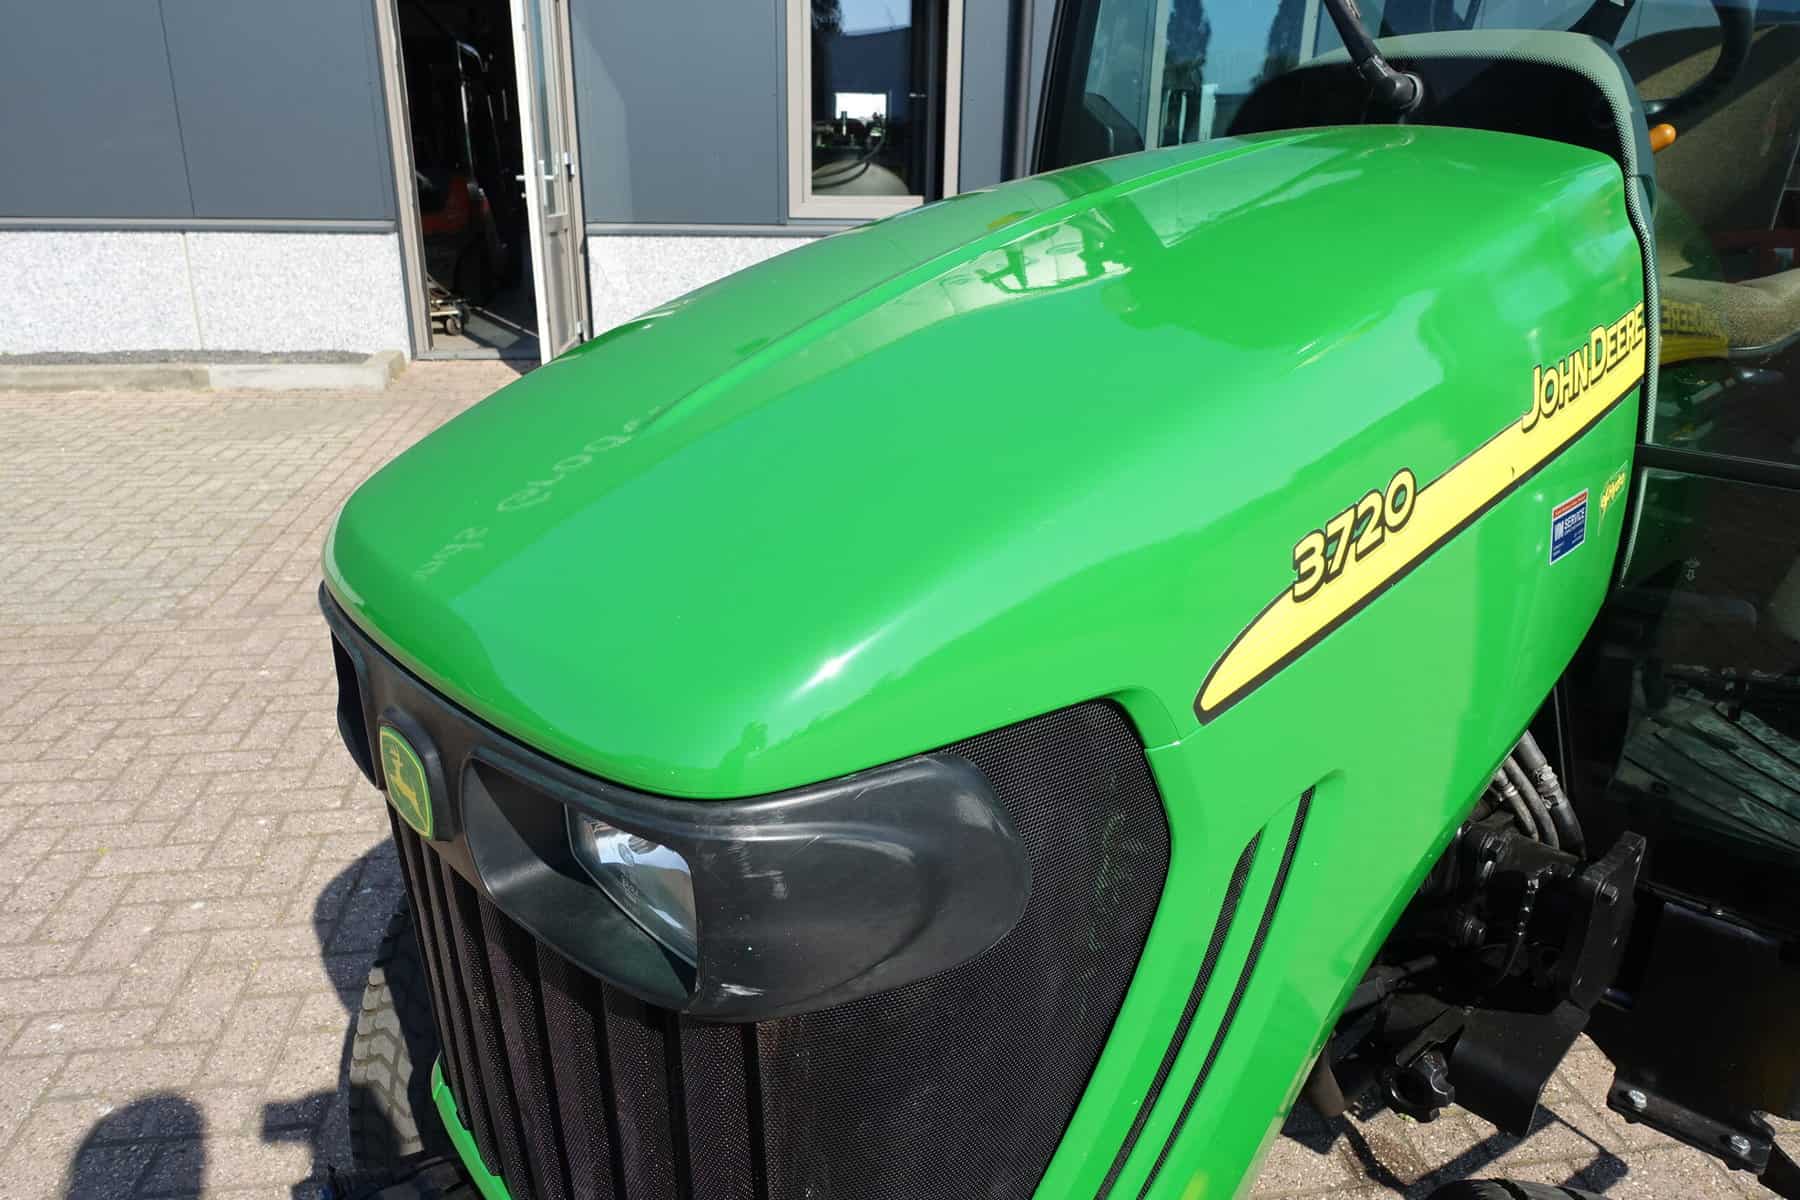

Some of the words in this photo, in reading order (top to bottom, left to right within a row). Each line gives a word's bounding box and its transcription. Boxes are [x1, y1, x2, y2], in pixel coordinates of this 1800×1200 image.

[1522, 343, 1590, 434] JOHN
[1590, 302, 1644, 386] DEERE
[1293, 468, 1416, 602] 3720
